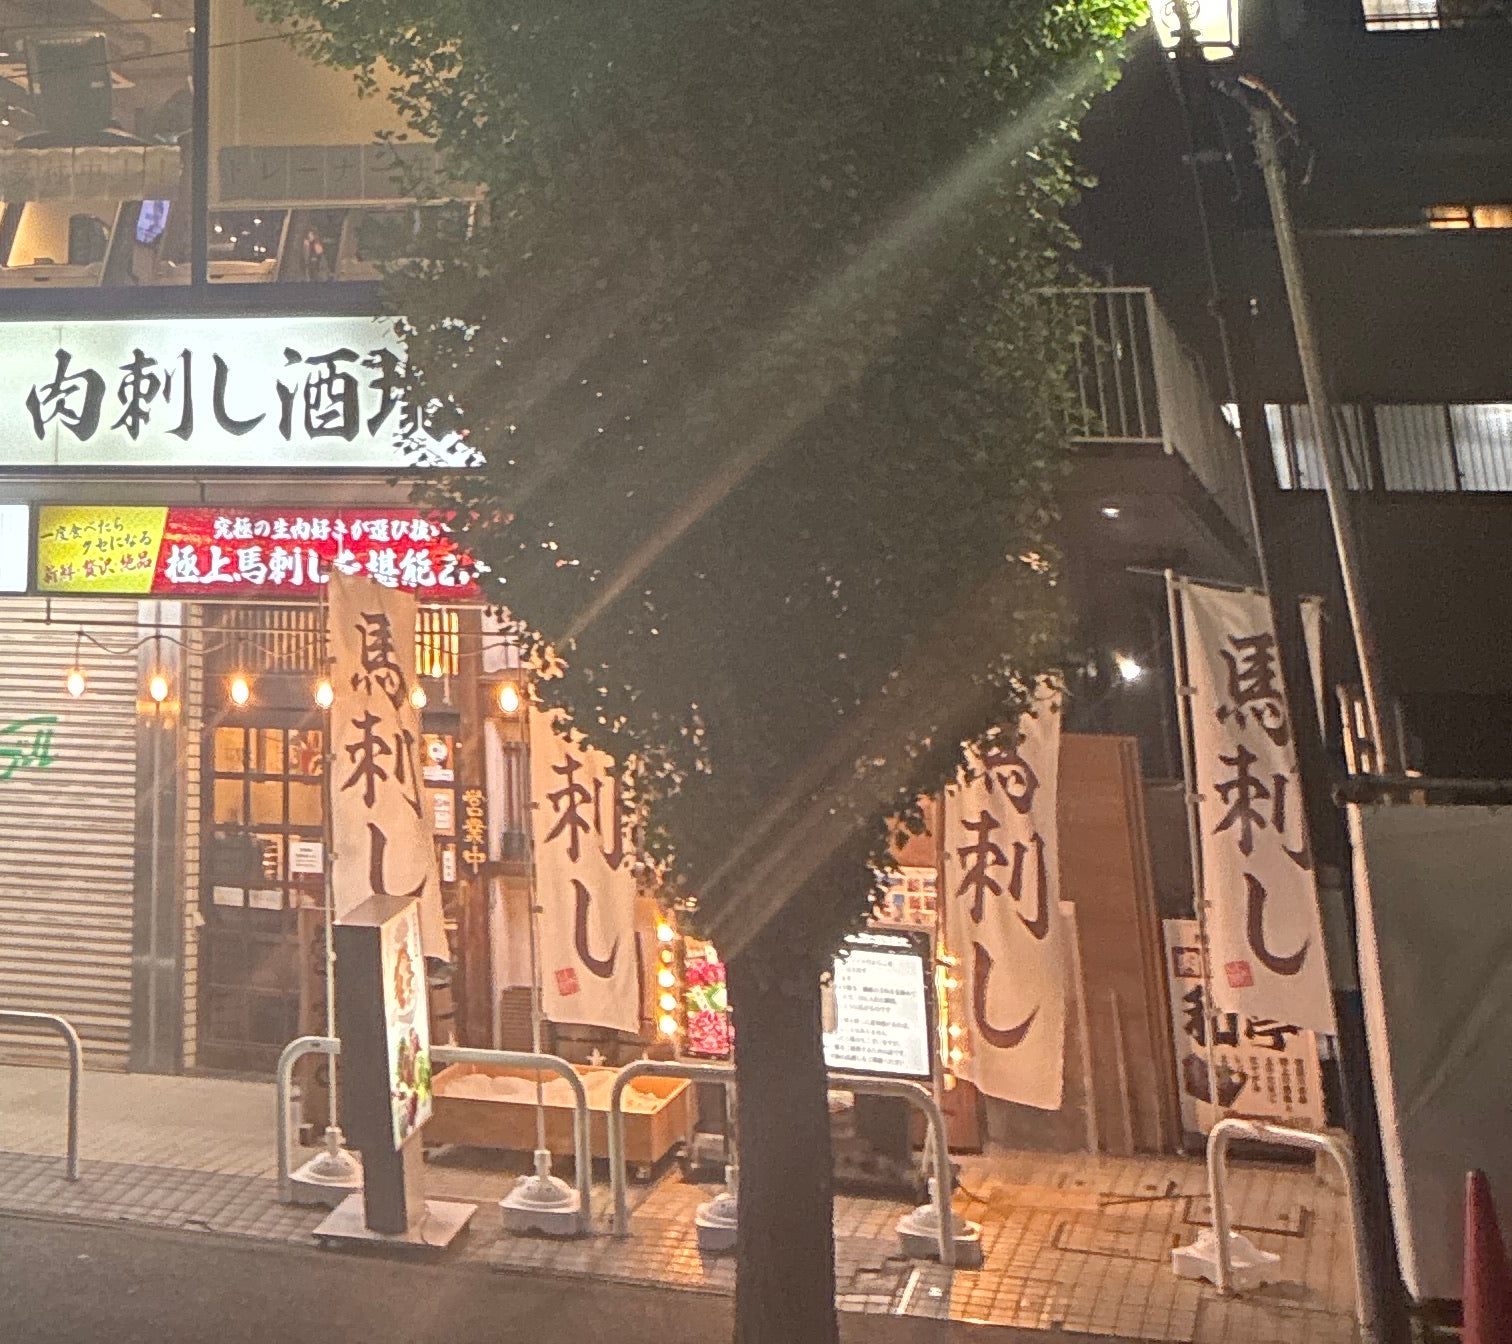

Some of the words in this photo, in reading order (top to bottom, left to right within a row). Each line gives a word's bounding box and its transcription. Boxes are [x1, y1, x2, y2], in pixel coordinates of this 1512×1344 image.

[340, 611, 427, 896] 馬刺し
[461, 788, 489, 874] 営業中
[543, 753, 625, 979] 刺し
[1212, 632, 1312, 975] 馬刺し
